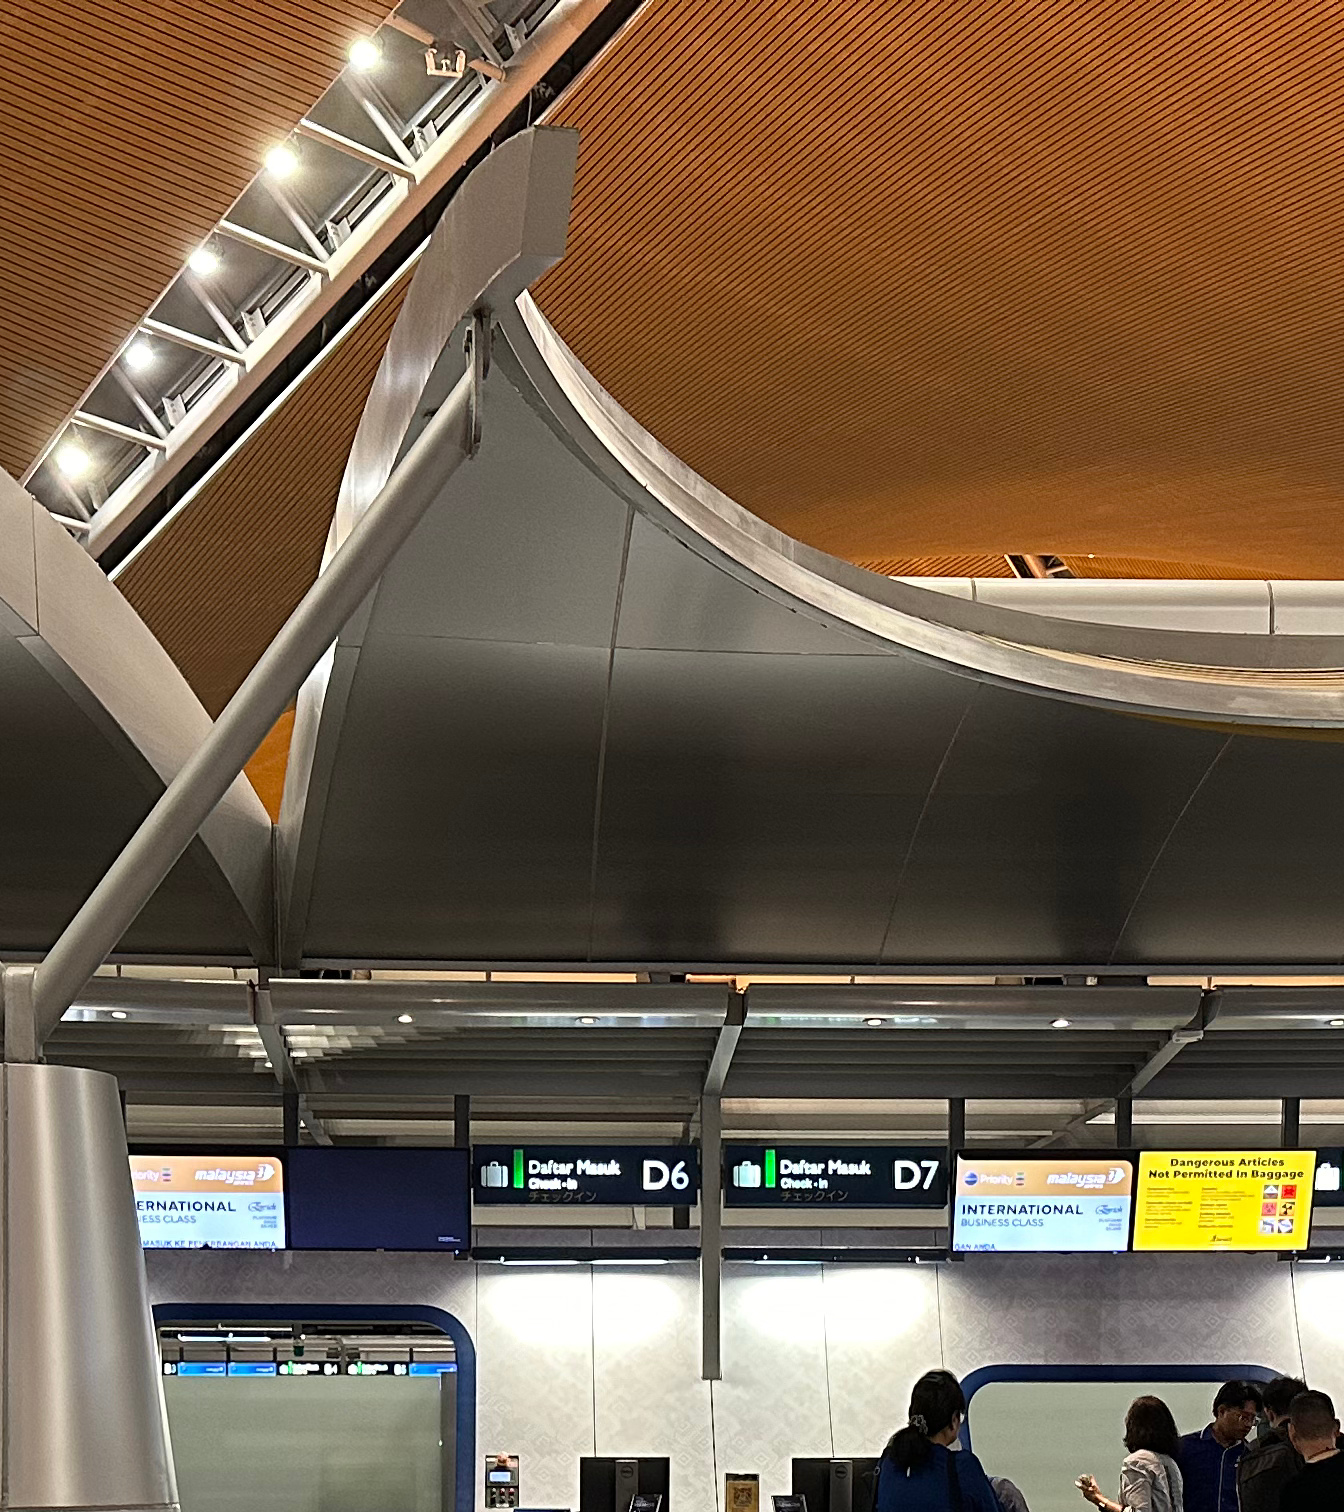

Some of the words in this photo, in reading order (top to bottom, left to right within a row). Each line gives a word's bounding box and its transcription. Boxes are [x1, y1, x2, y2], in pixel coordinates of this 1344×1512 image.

[529, 1160, 574, 1175] Daftar
[577, 1160, 621, 1175] Masuk
[780, 1160, 825, 1174] Daftar
[828, 1160, 871, 1175] Masuk
[1170, 1158, 1235, 1168] Dangerous
[1238, 1157, 1285, 1166] Articles
[194, 1168, 256, 1184] malaysia
[643, 1160, 689, 1190] D6
[894, 1160, 939, 1190] D7
[1046, 1172, 1106, 1188] malaysia
[1149, 1170, 1170, 1178] Not
[1173, 1169, 1233, 1179] Permitted
[1236, 1170, 1248, 1178] In
[1251, 1170, 1305, 1180] Baggage
[136, 1201, 236, 1212] ERNATIONAL
[962, 1205, 1084, 1214] INTERNATIONAL
[163, 1215, 196, 1224] CLASS
[960, 1219, 1010, 1227] BUSINESS
[1012, 1219, 1044, 1227] CLASS
